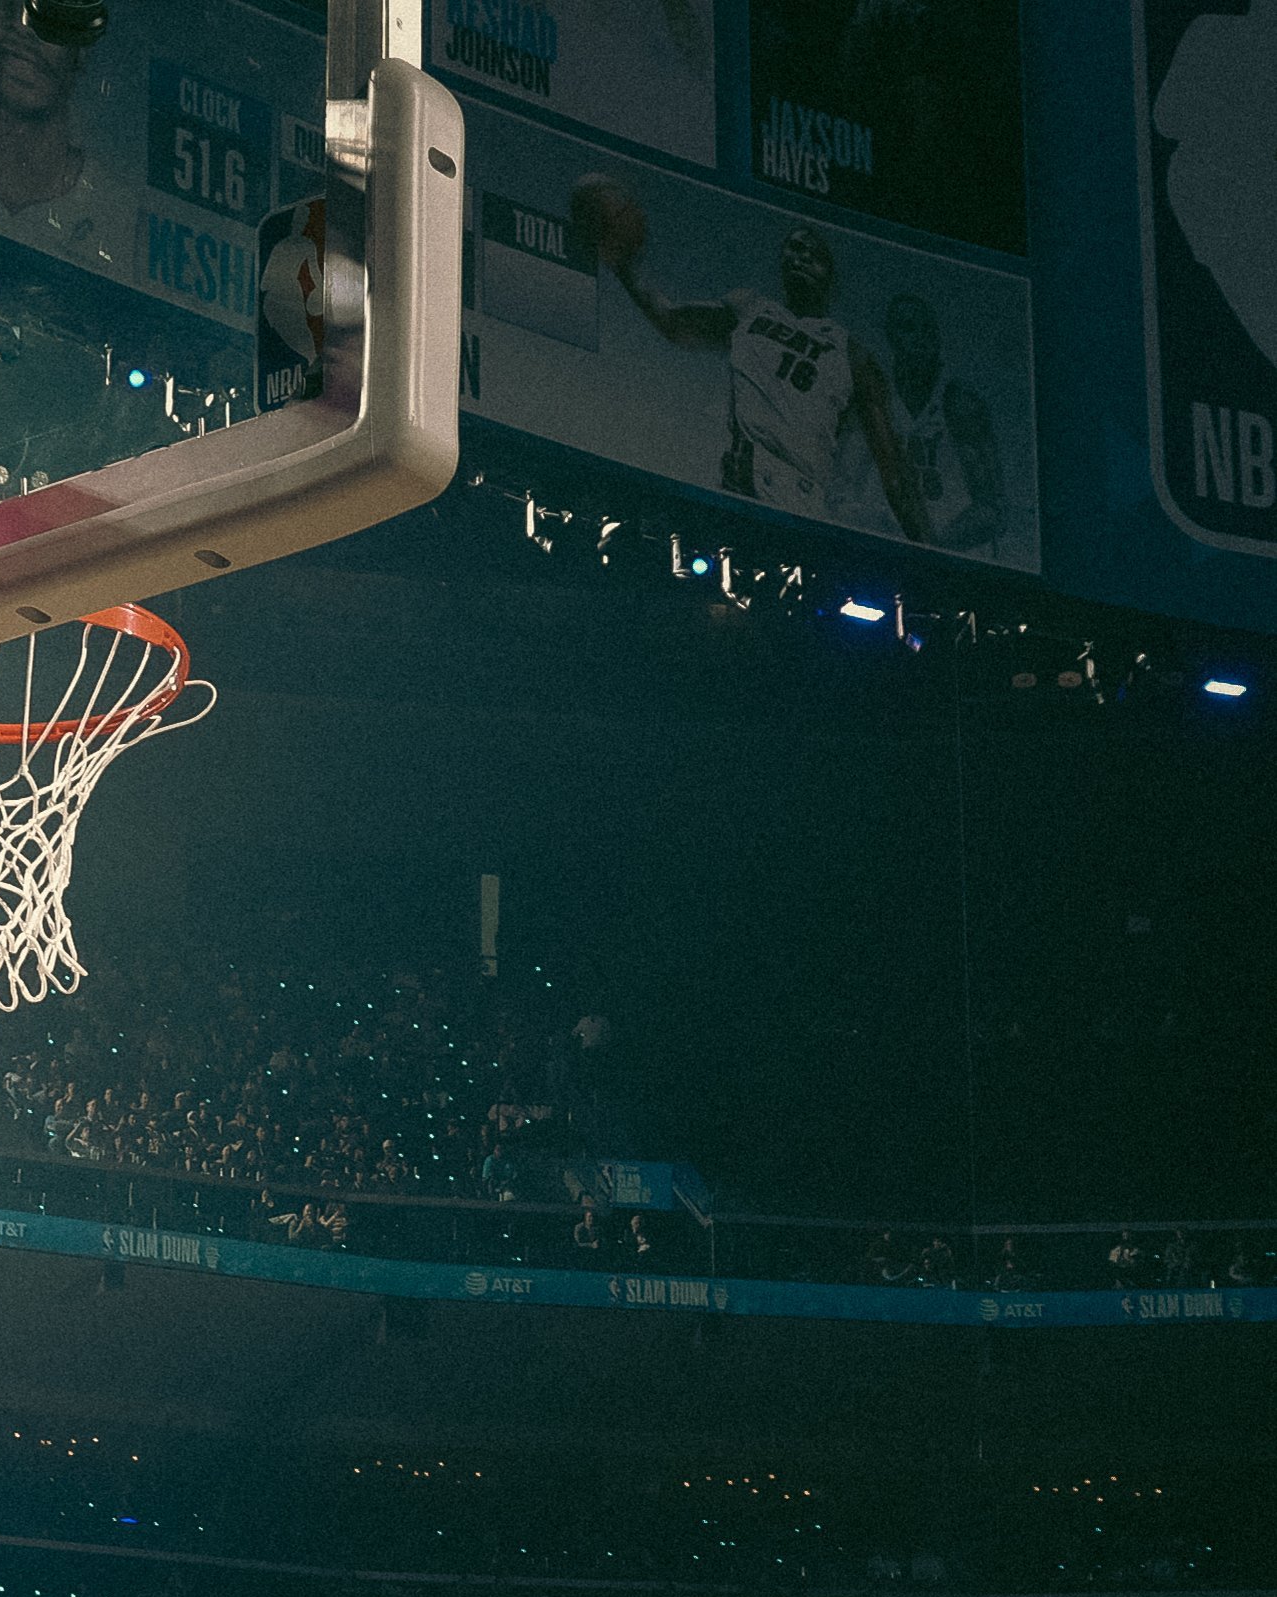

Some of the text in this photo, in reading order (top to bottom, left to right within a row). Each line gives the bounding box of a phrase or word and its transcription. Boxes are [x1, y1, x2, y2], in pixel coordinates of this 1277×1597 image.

[445, 23, 551, 98] JOHNSON
[178, 77, 242, 135] CLOCK
[761, 96, 874, 176] JAXSON
[173, 127, 246, 212] 51.6
[761, 137, 830, 194] HAYES
[512, 208, 567, 260] TOTAL
[147, 212, 255, 318] KESH
[1190, 400, 1277, 510] NB
[118, 1229, 201, 1266] SLAM DUNK
[490, 1276, 533, 1295] AT&T
[625, 1278, 709, 1307] SLAM DUNK
[1003, 1302, 1045, 1319] AT&T
[1138, 1293, 1223, 1319] SLAM DUNK
